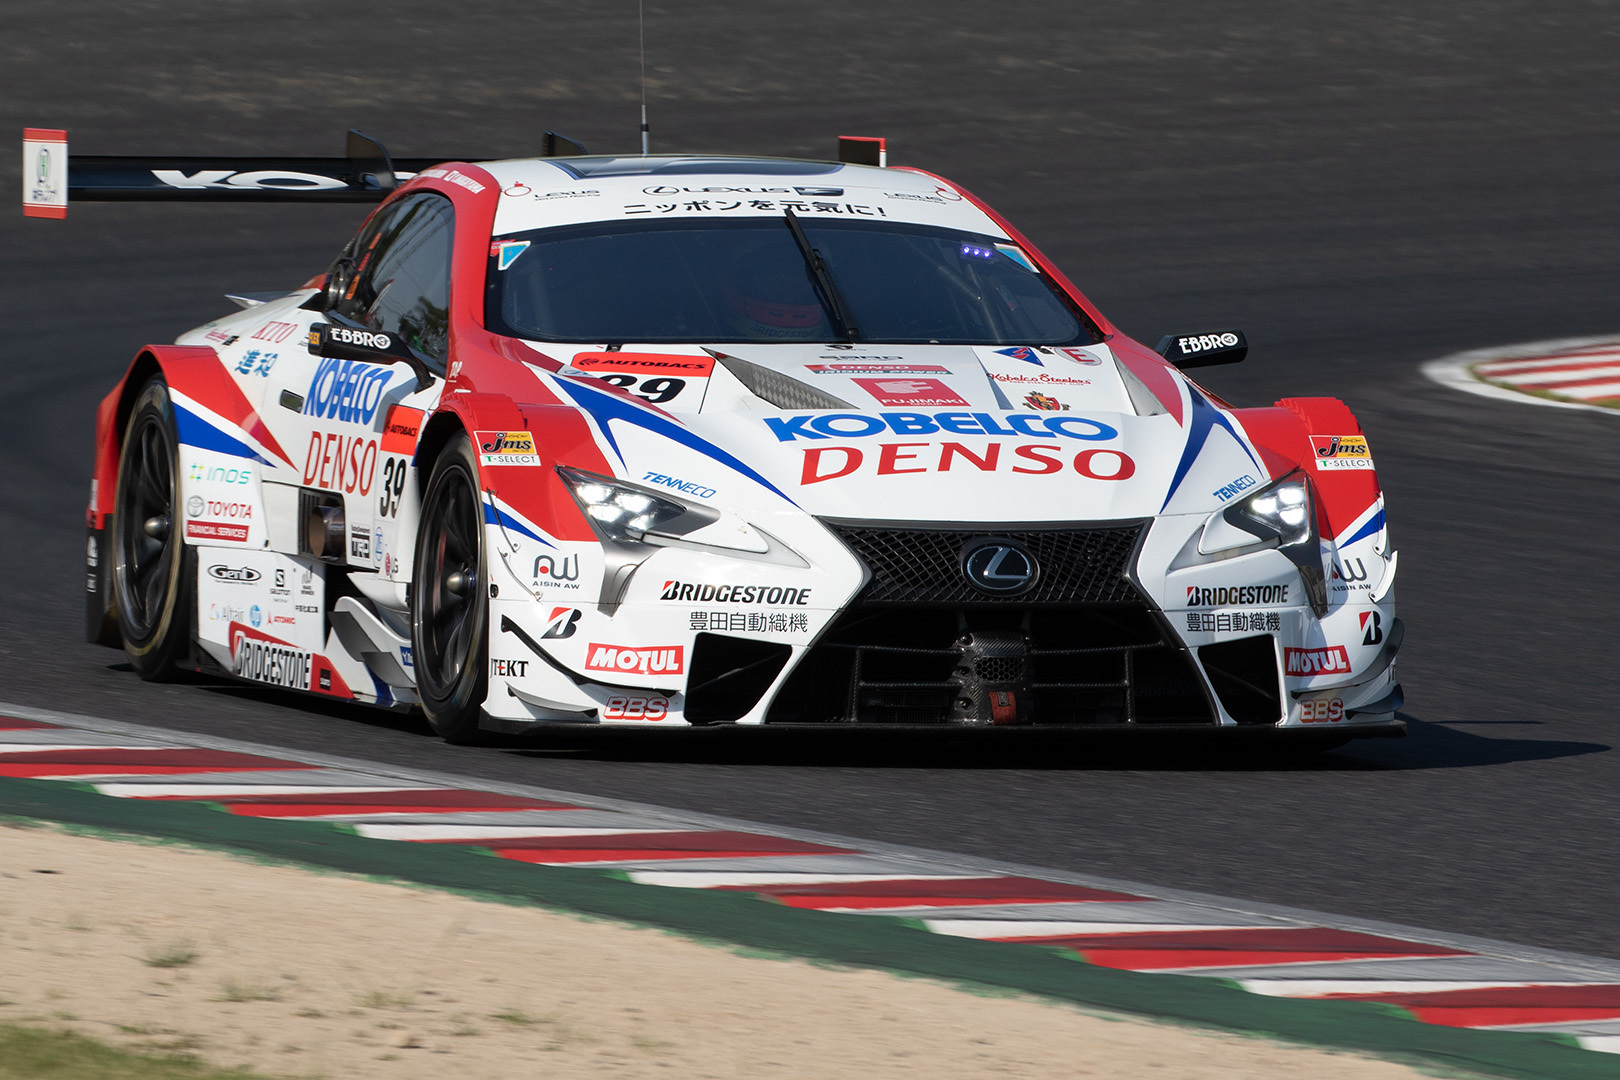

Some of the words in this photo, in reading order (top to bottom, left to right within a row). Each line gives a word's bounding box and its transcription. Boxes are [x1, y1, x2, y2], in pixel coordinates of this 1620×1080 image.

[602, 360, 706, 369] AUTOBACS
[303, 358, 394, 425] KOBELCO
[390, 425, 417, 437] AUTOBACS
[763, 412, 1118, 442] KOBELCO
[303, 431, 377, 496] DENSO
[800, 442, 1136, 485] DENSO
[380, 456, 406, 519] 39
[642, 471, 717, 499] TENNECO
[1213, 474, 1257, 502] TENNECO
[208, 501, 252, 519] TOYOTA
[532, 580, 561, 588] AISIN
[564, 582, 580, 590] AW
[660, 580, 811, 605] BRIDGESTONE
[1187, 584, 1289, 606] BRIDGESTONE
[690, 611, 808, 632] 豊田自動織機
[1187, 612, 1280, 632] 豊田自動織機
[233, 631, 310, 689] BRIDGESTONE
[590, 648, 679, 671] MOTUL
[1288, 650, 1347, 674] MOTUL
[603, 697, 669, 721] BBS
[1299, 698, 1344, 724] BBS
